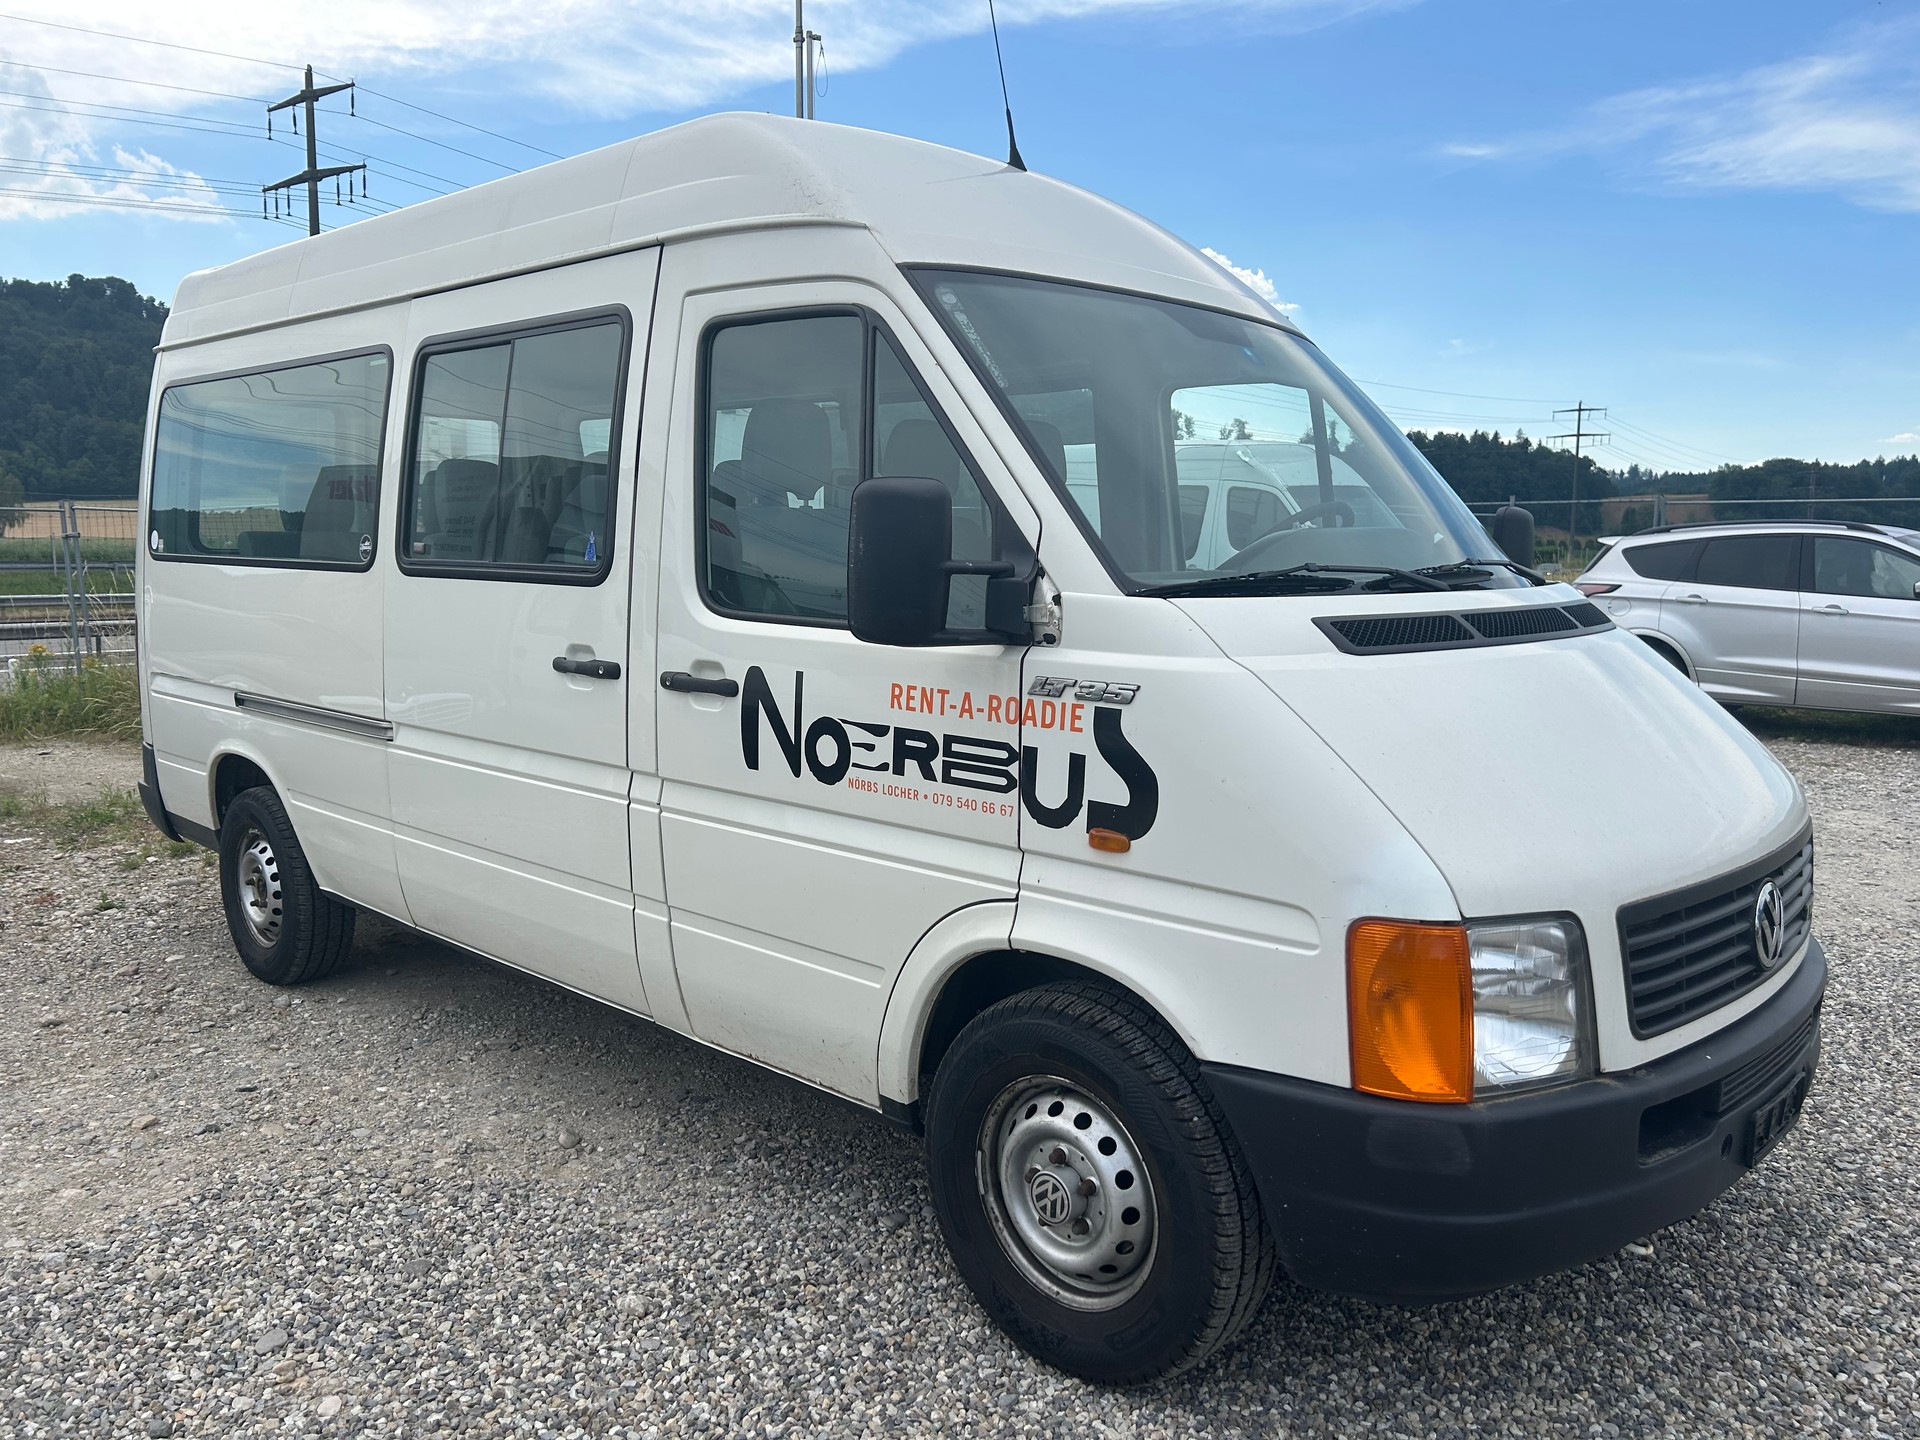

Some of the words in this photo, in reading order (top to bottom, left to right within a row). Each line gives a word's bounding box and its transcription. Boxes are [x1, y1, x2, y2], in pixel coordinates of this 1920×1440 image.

[891, 682, 1084, 733] RENT-A-ROADIE
[1027, 675, 1077, 698] LT
[1074, 680, 1141, 705] 35
[847, 776, 879, 794] NÖRBS
[882, 783, 919, 801] LOCHER
[932, 793, 953, 807] 079
[956, 797, 978, 811] 540
[981, 801, 996, 815] 66
[1000, 804, 1014, 818] 67
